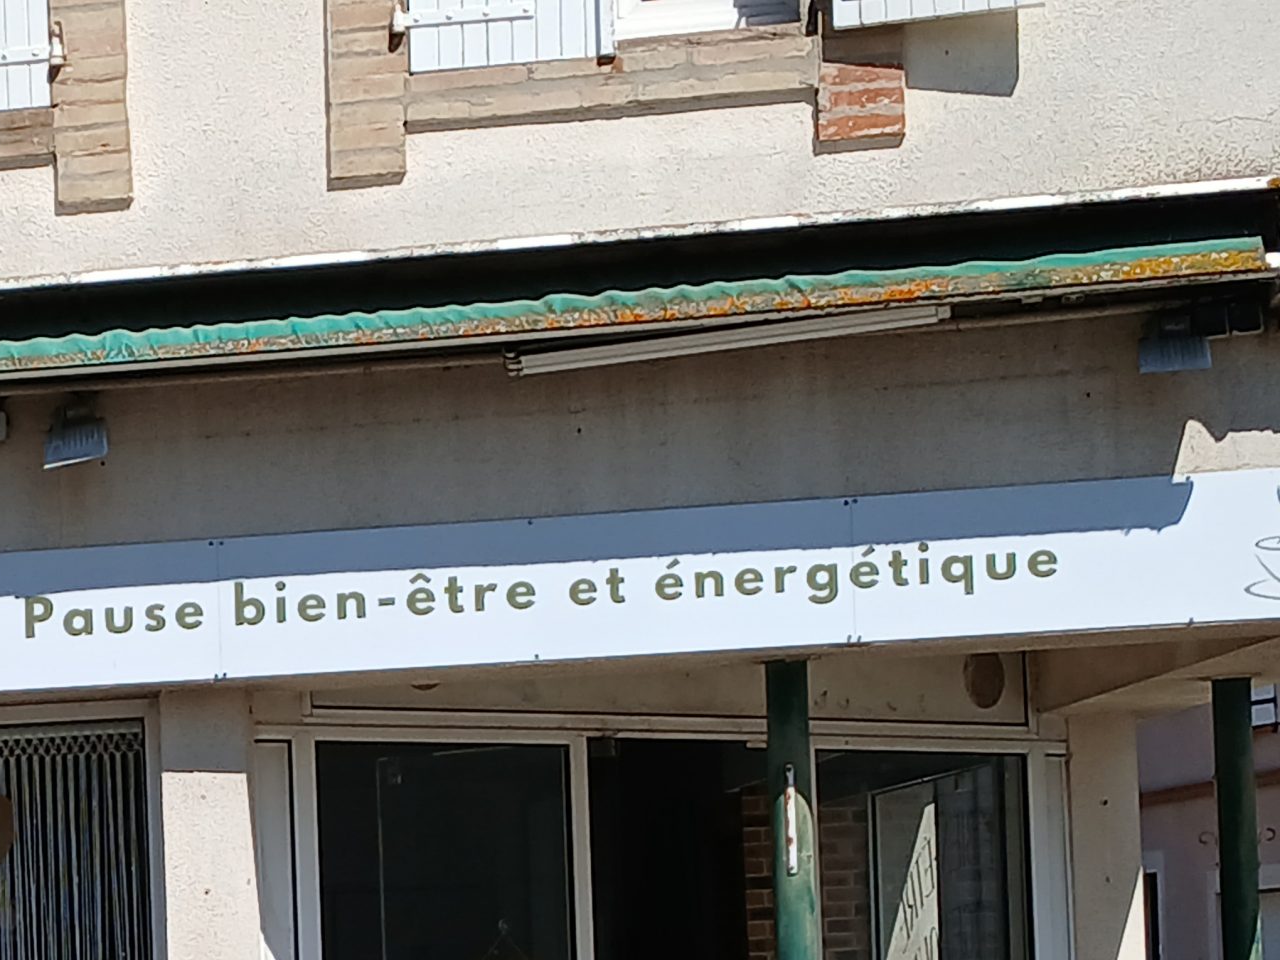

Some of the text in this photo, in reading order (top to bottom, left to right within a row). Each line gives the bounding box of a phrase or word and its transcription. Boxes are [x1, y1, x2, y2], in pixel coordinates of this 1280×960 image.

[24, 541, 1059, 639] Pause bien-être et énergétique
